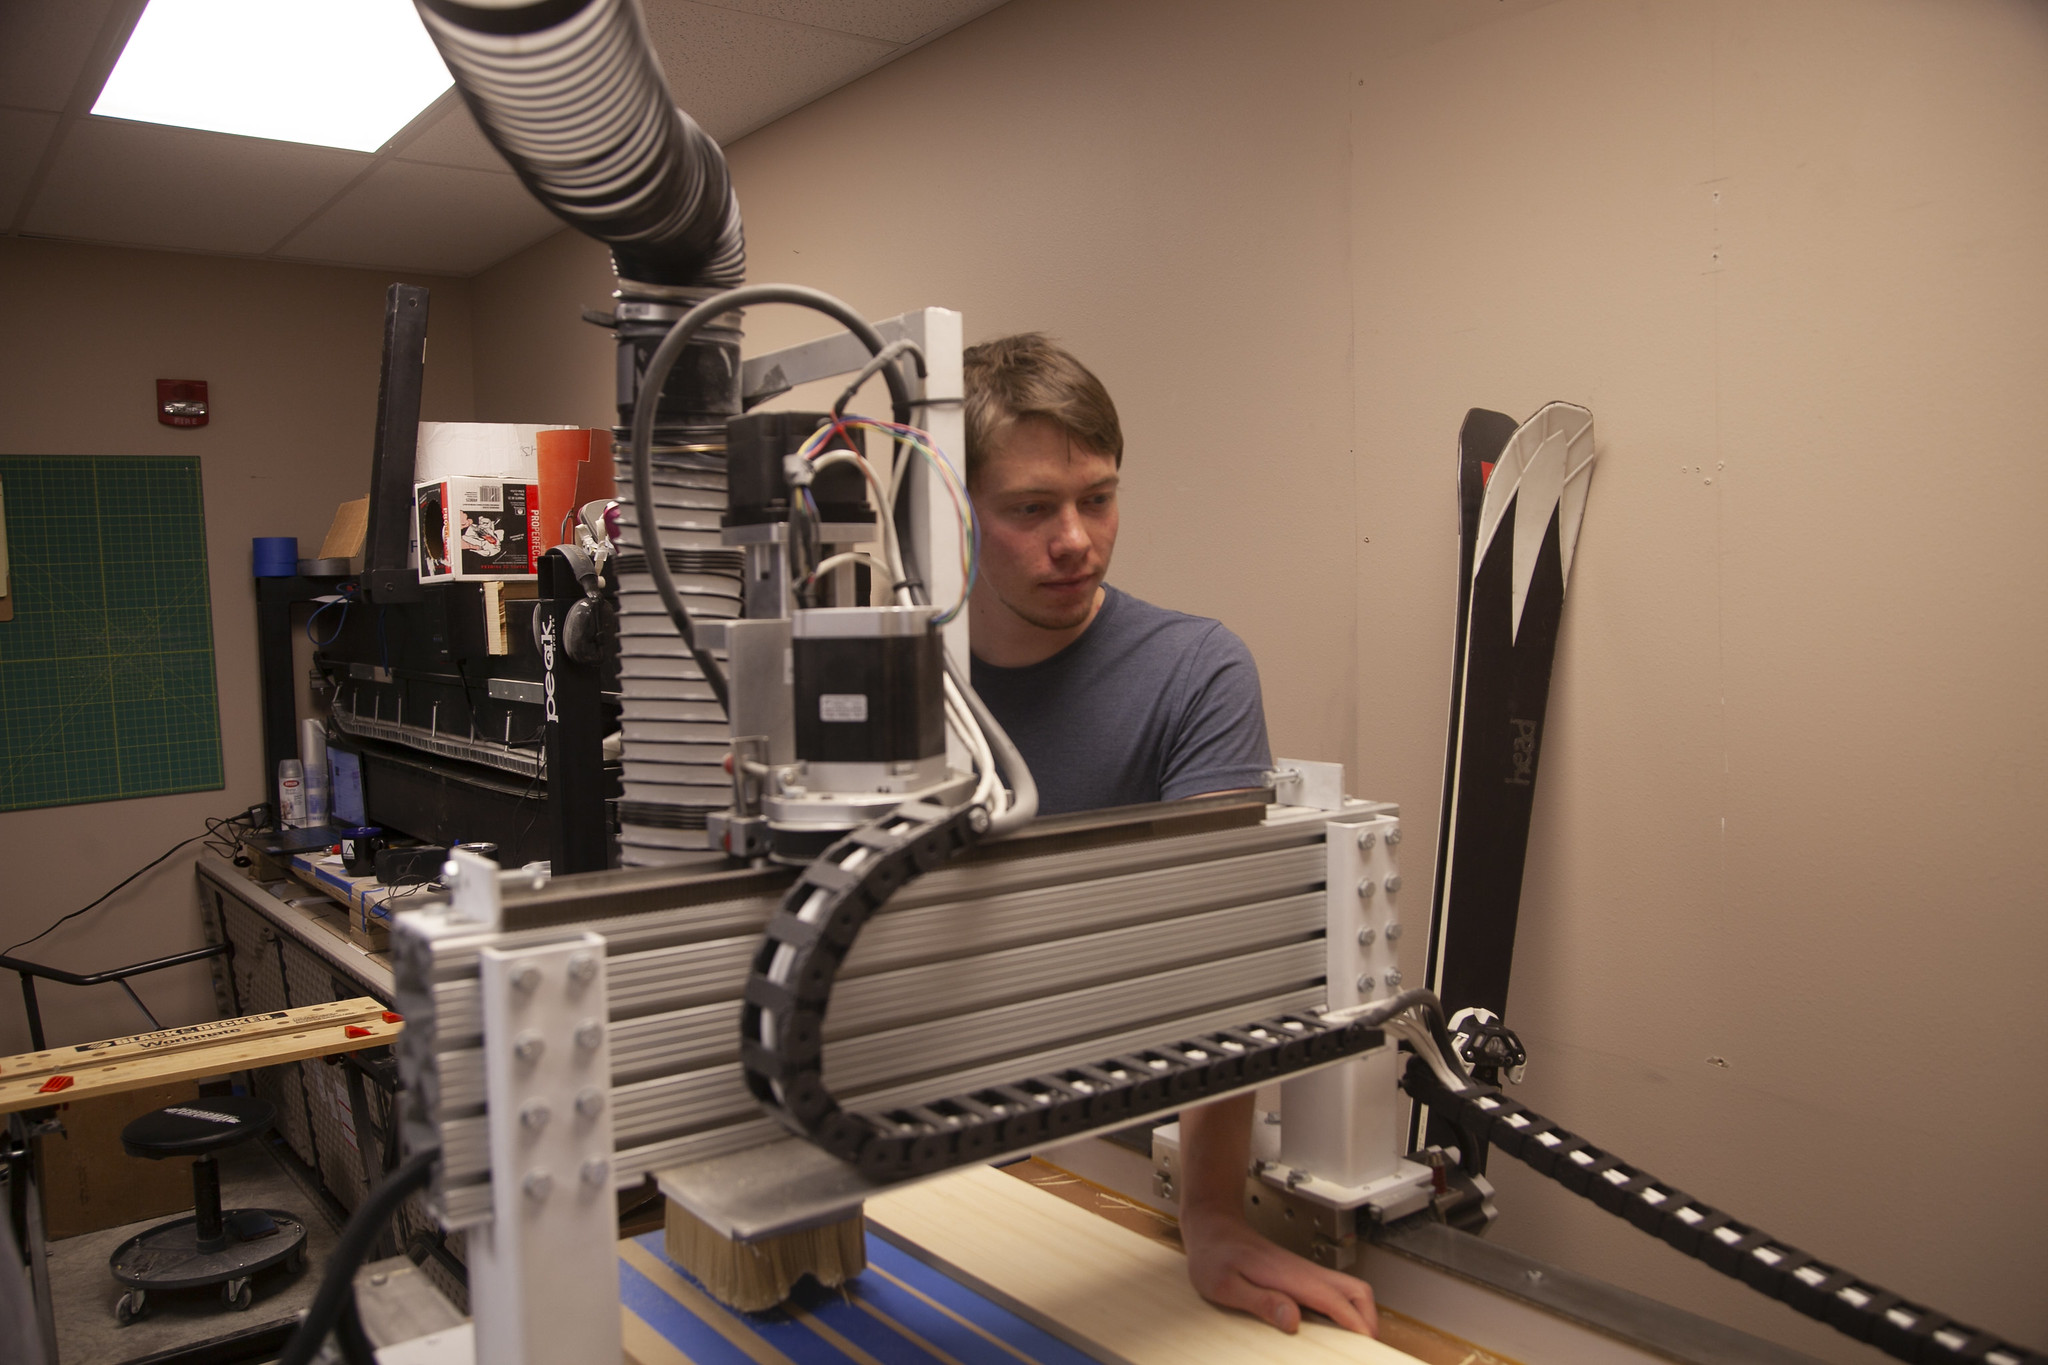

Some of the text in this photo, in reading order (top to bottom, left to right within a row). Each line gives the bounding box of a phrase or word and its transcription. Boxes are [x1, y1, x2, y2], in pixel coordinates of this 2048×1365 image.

[174, 417, 197, 425] FIRE
[116, 1030, 178, 1046] BLACK
[196, 1015, 272, 1032] DECKER
[139, 1028, 242, 1048] Workmate
